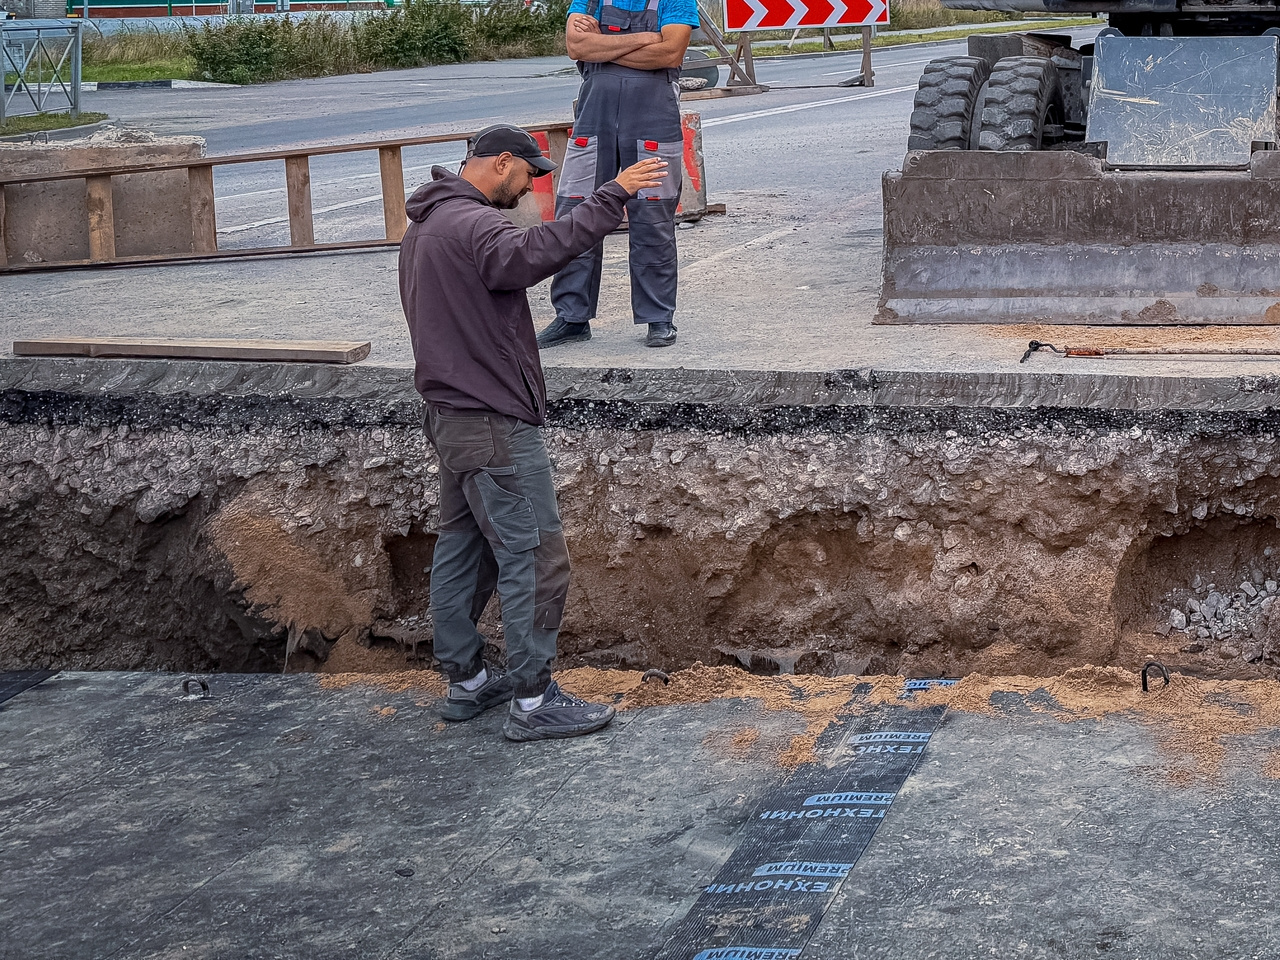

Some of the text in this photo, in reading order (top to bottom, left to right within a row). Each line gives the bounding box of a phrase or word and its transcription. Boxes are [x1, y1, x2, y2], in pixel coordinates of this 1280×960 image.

[858, 733, 931, 742] PREMIUM
[815, 793, 893, 803] PREMIUM
[766, 864, 851, 875] PREMIUM
